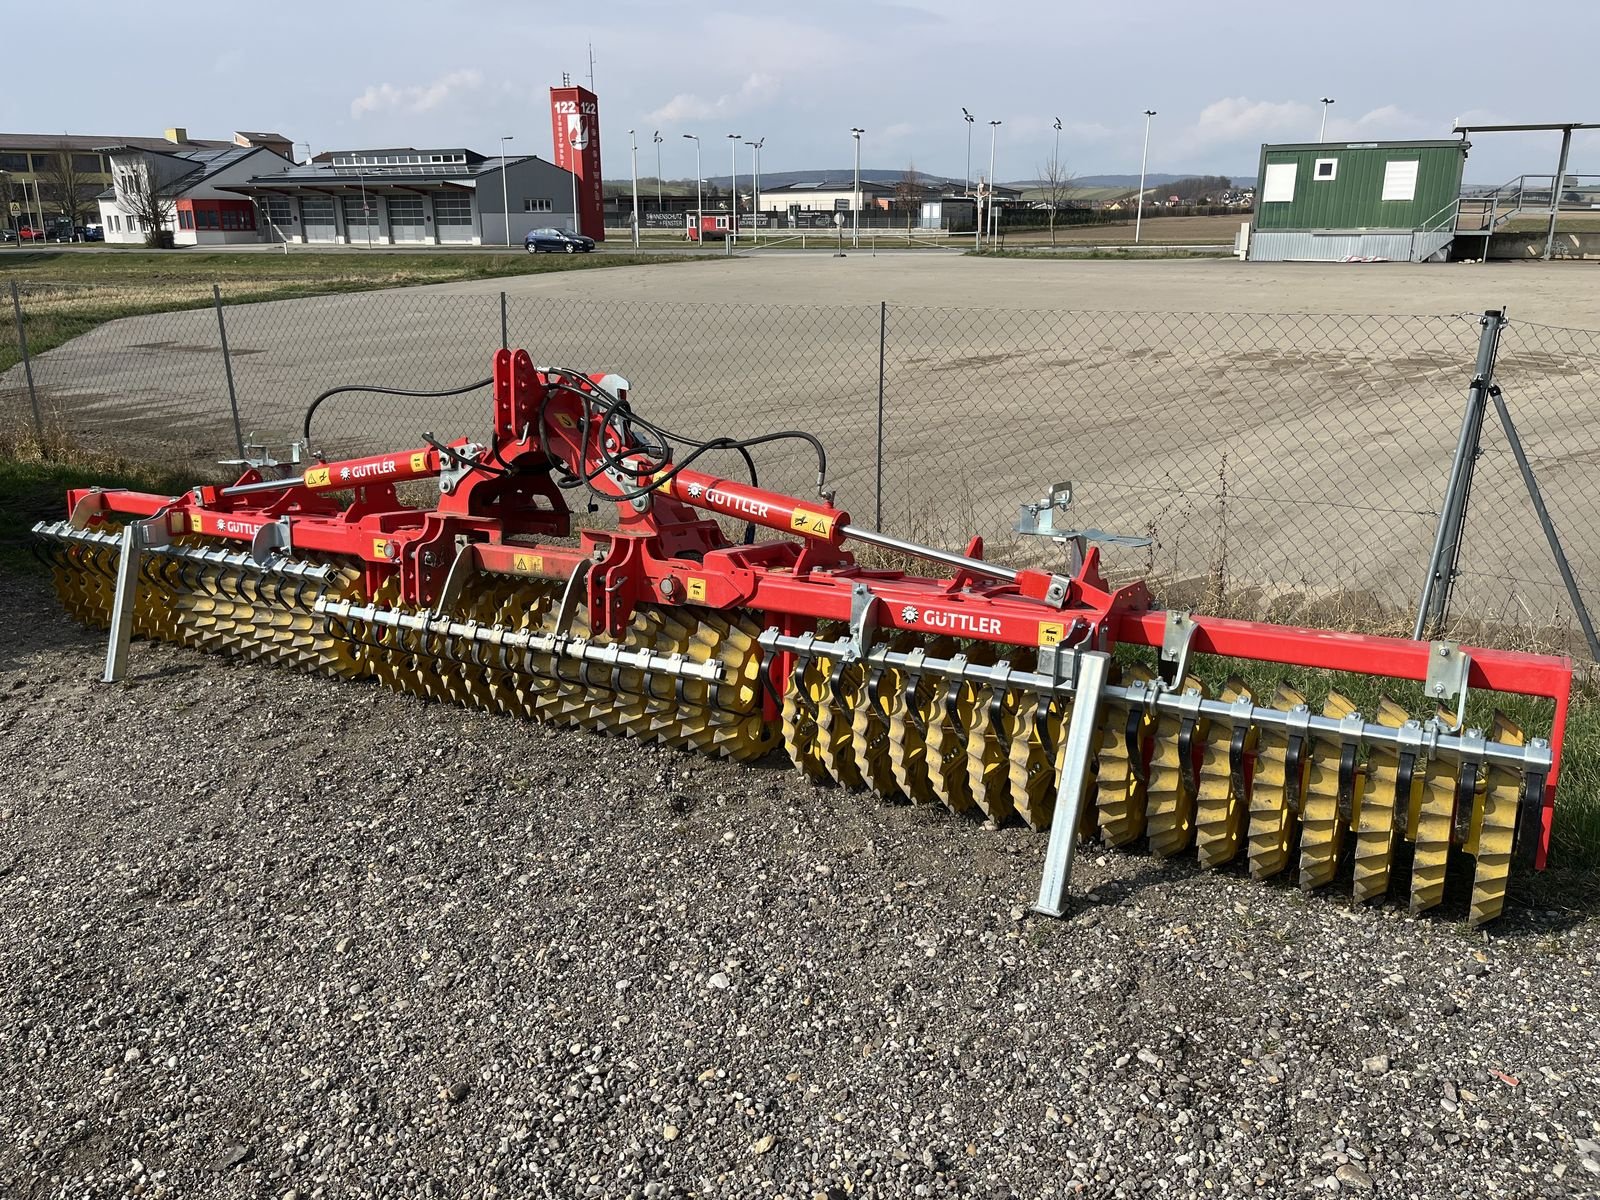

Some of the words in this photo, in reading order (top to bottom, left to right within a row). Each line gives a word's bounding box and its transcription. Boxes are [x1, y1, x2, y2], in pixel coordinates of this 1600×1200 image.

[554, 101, 576, 114] 122
[581, 102, 596, 114] 122
[352, 460, 396, 478] GÜTTLER
[228, 521, 262, 534] GÜTTLE
[923, 610, 1002, 634] GÜTTLER
